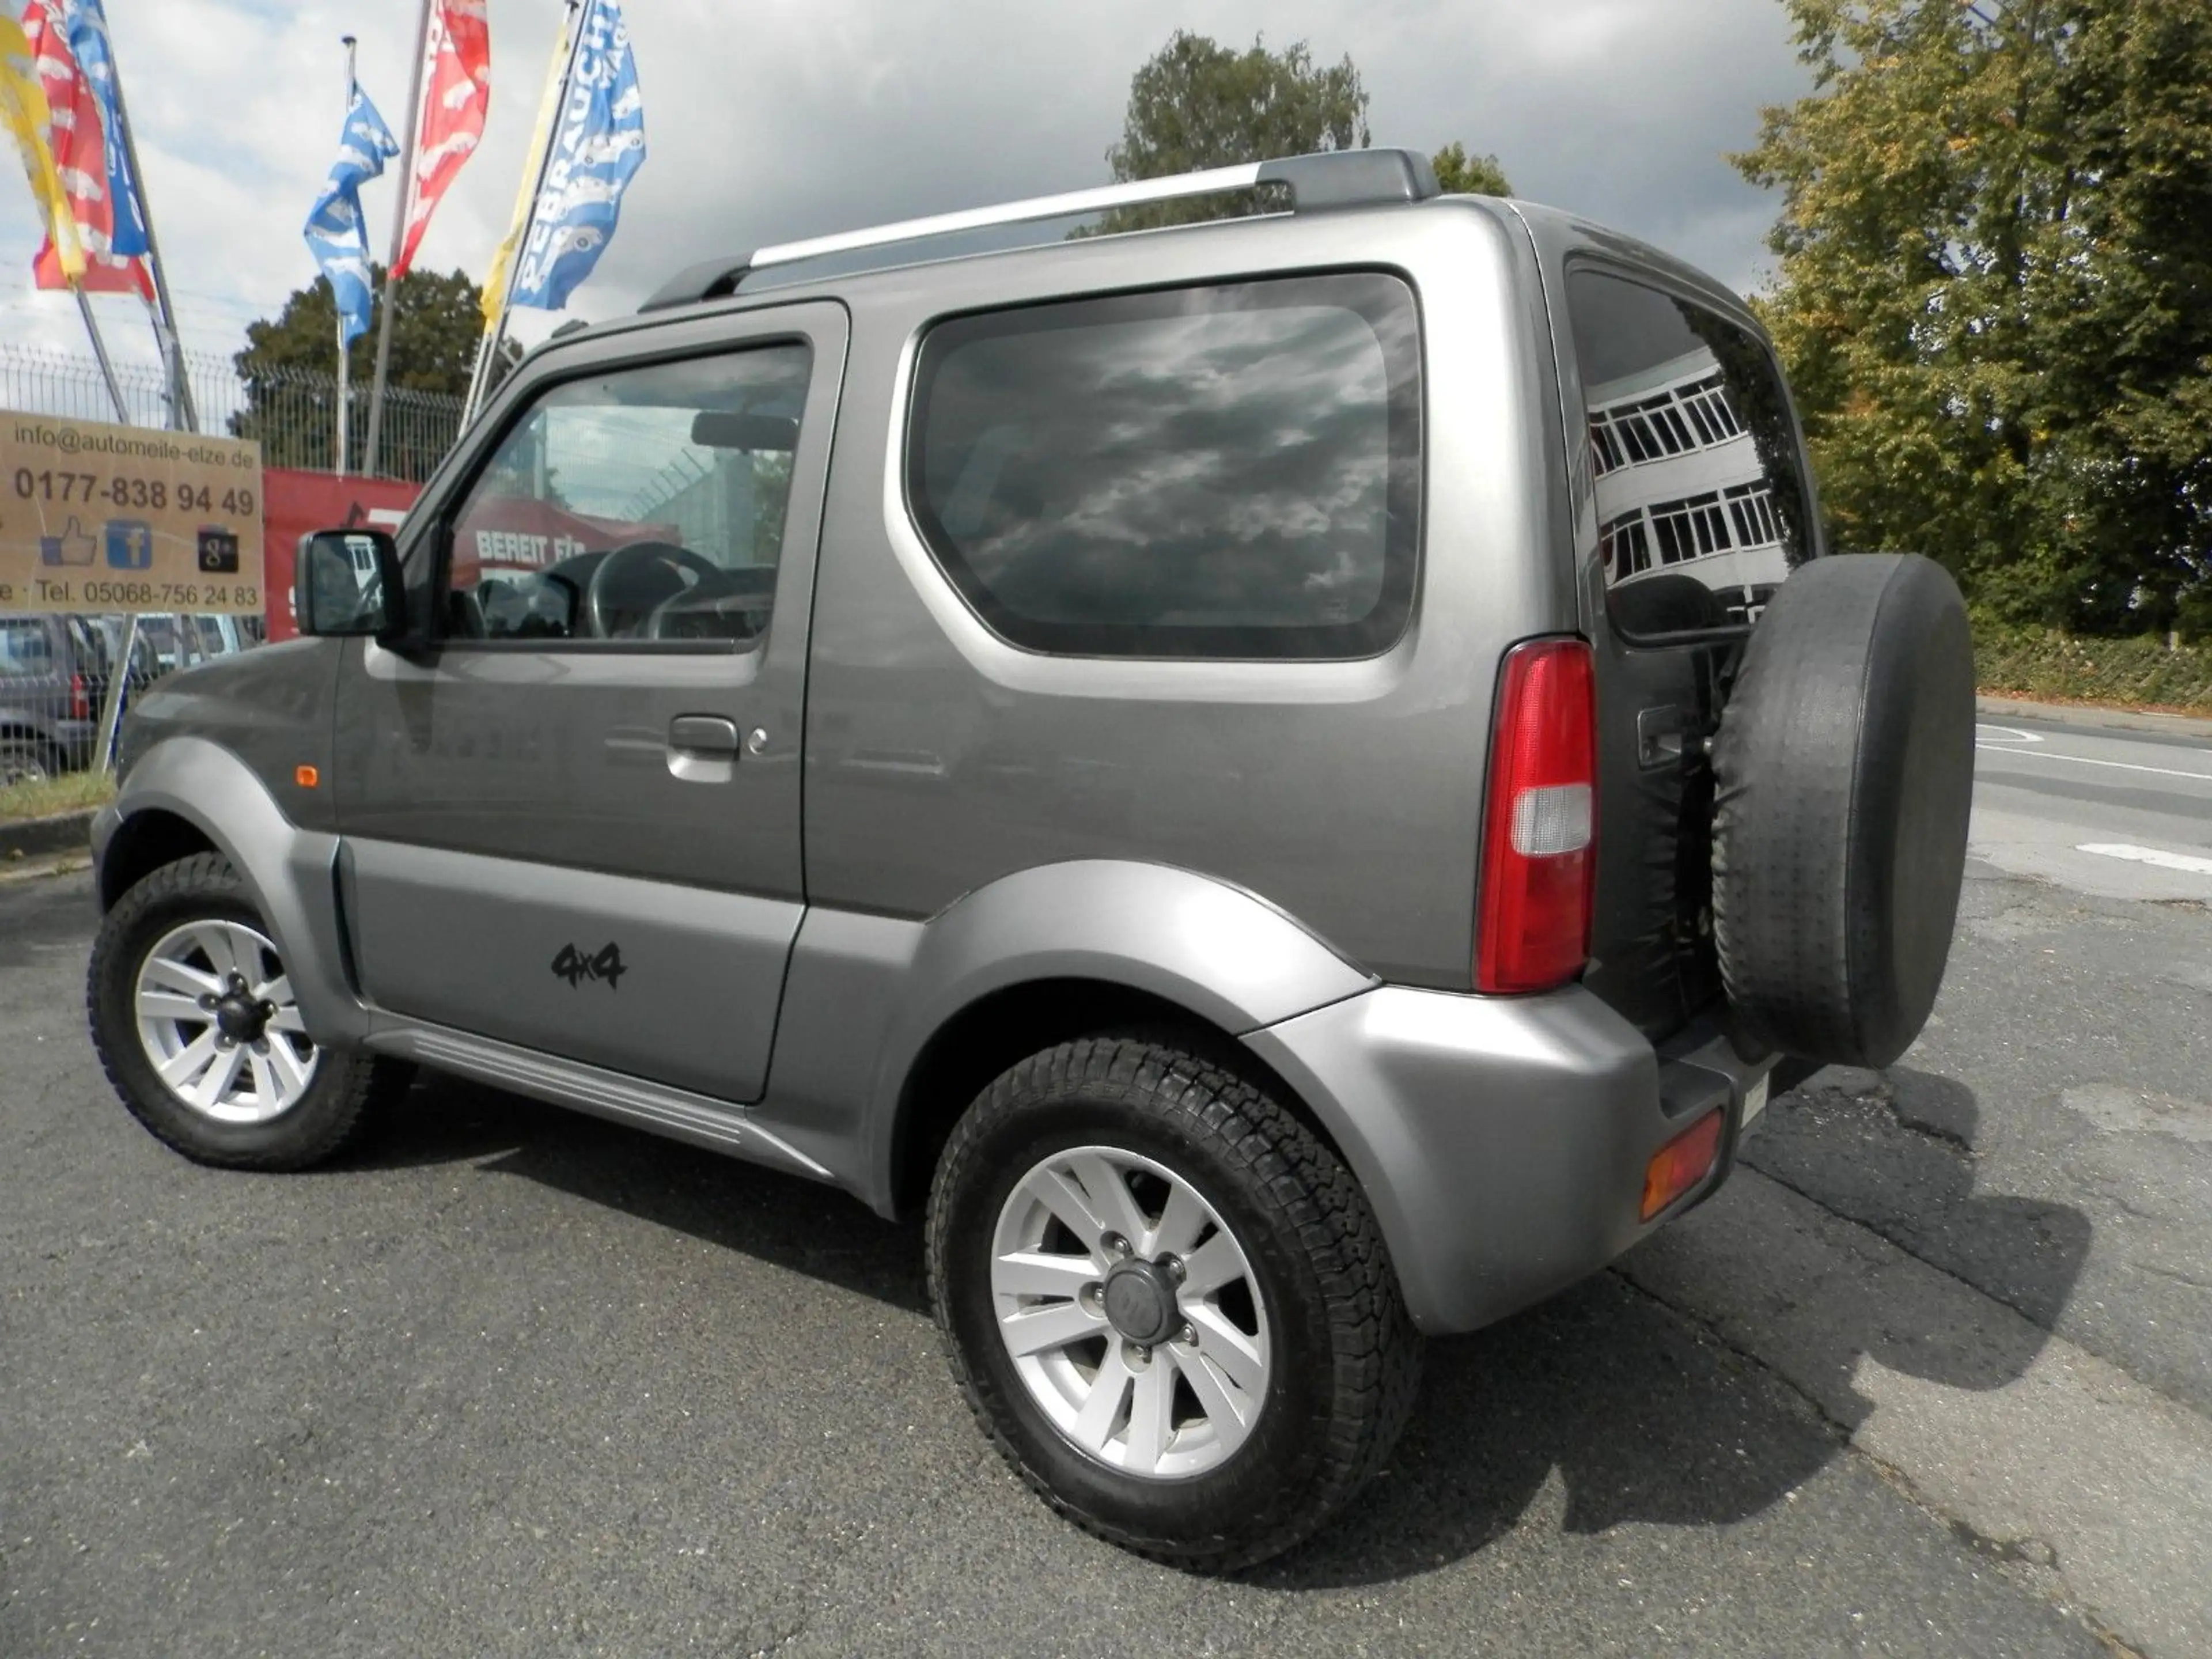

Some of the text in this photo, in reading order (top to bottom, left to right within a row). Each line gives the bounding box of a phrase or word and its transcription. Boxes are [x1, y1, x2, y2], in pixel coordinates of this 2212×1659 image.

[15, 421, 253, 469] info@automeile-elze.de
[16, 467, 253, 516] 0177-838 94 49
[476, 530, 548, 564] BEREIT
[35, 579, 77, 602] Tel.
[85, 581, 197, 604] 05068-756
[204, 585, 226, 604] 24
[234, 586, 257, 605] 83
[551, 941, 628, 994] 4x4
